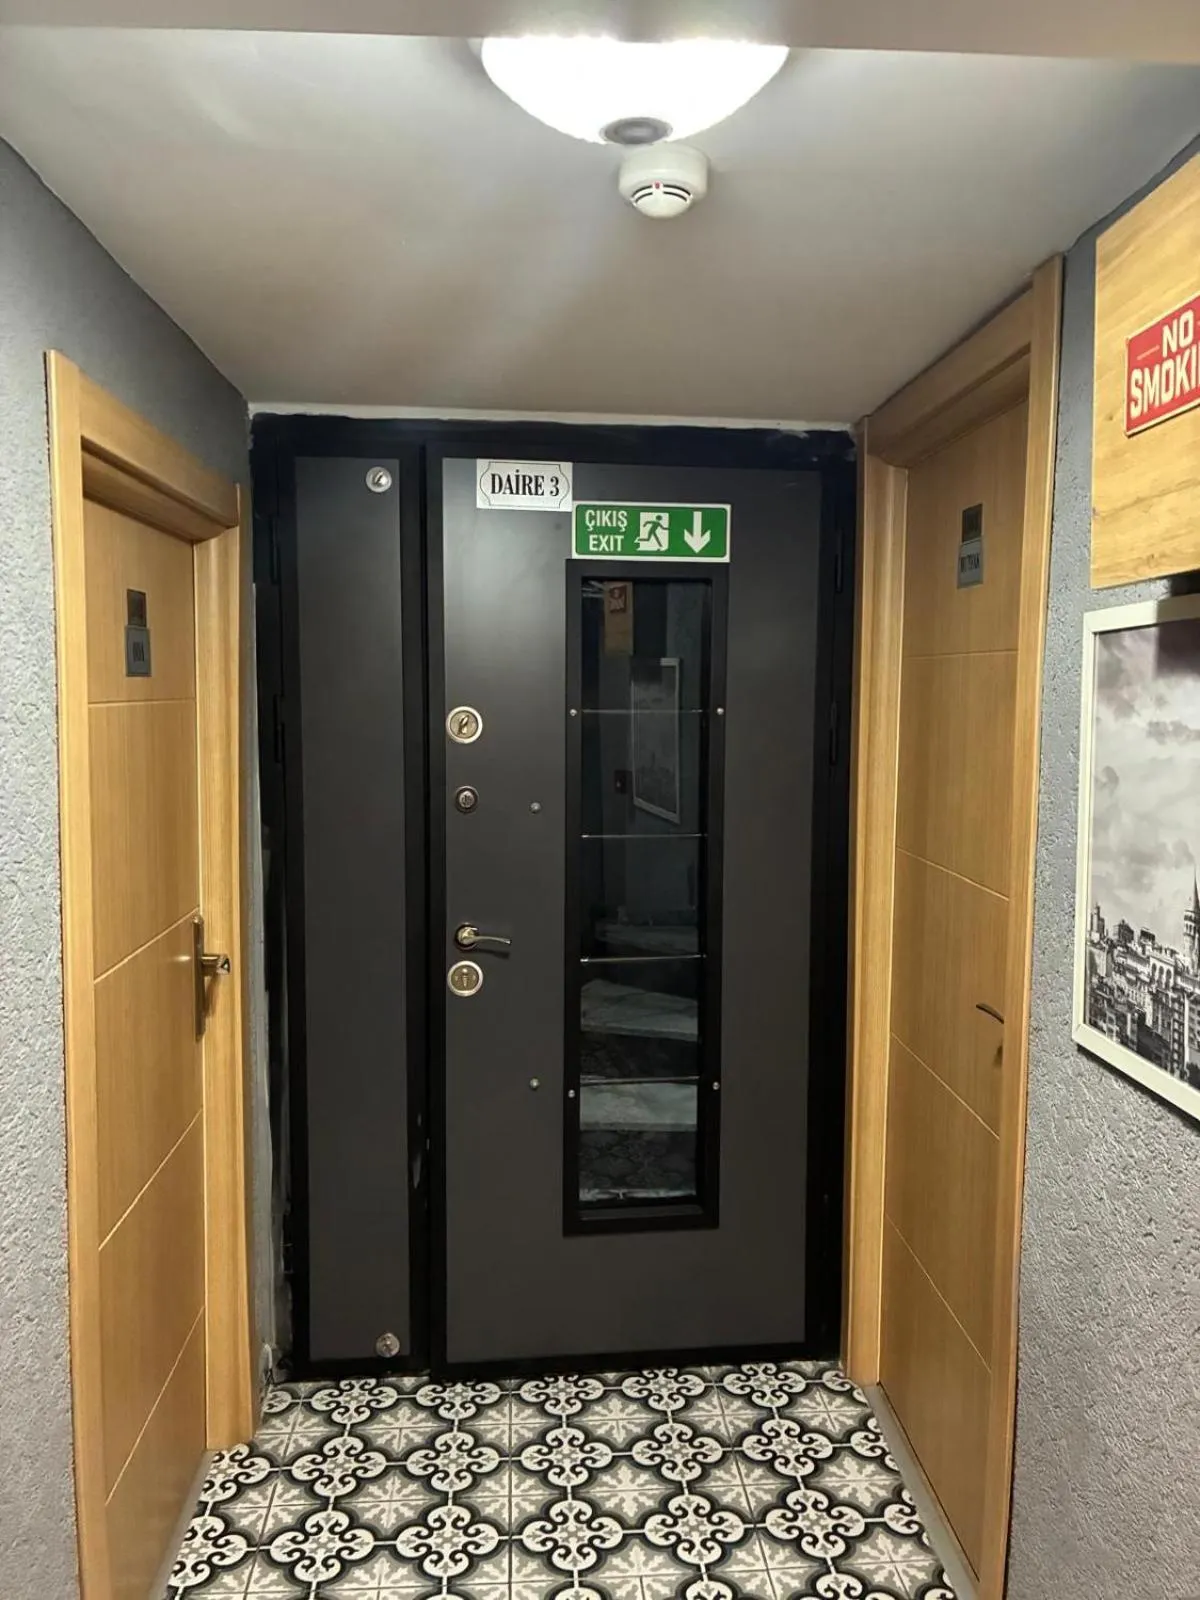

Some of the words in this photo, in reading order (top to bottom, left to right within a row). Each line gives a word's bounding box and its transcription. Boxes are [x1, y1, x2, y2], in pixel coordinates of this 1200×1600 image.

[1162, 309, 1194, 358] NO
[1130, 342, 1200, 419] SMOKI
[490, 469, 545, 496] DAİRE
[549, 476, 560, 497] 3
[585, 510, 628, 532] ÇIKIŞ
[589, 535, 624, 552] EXIT
